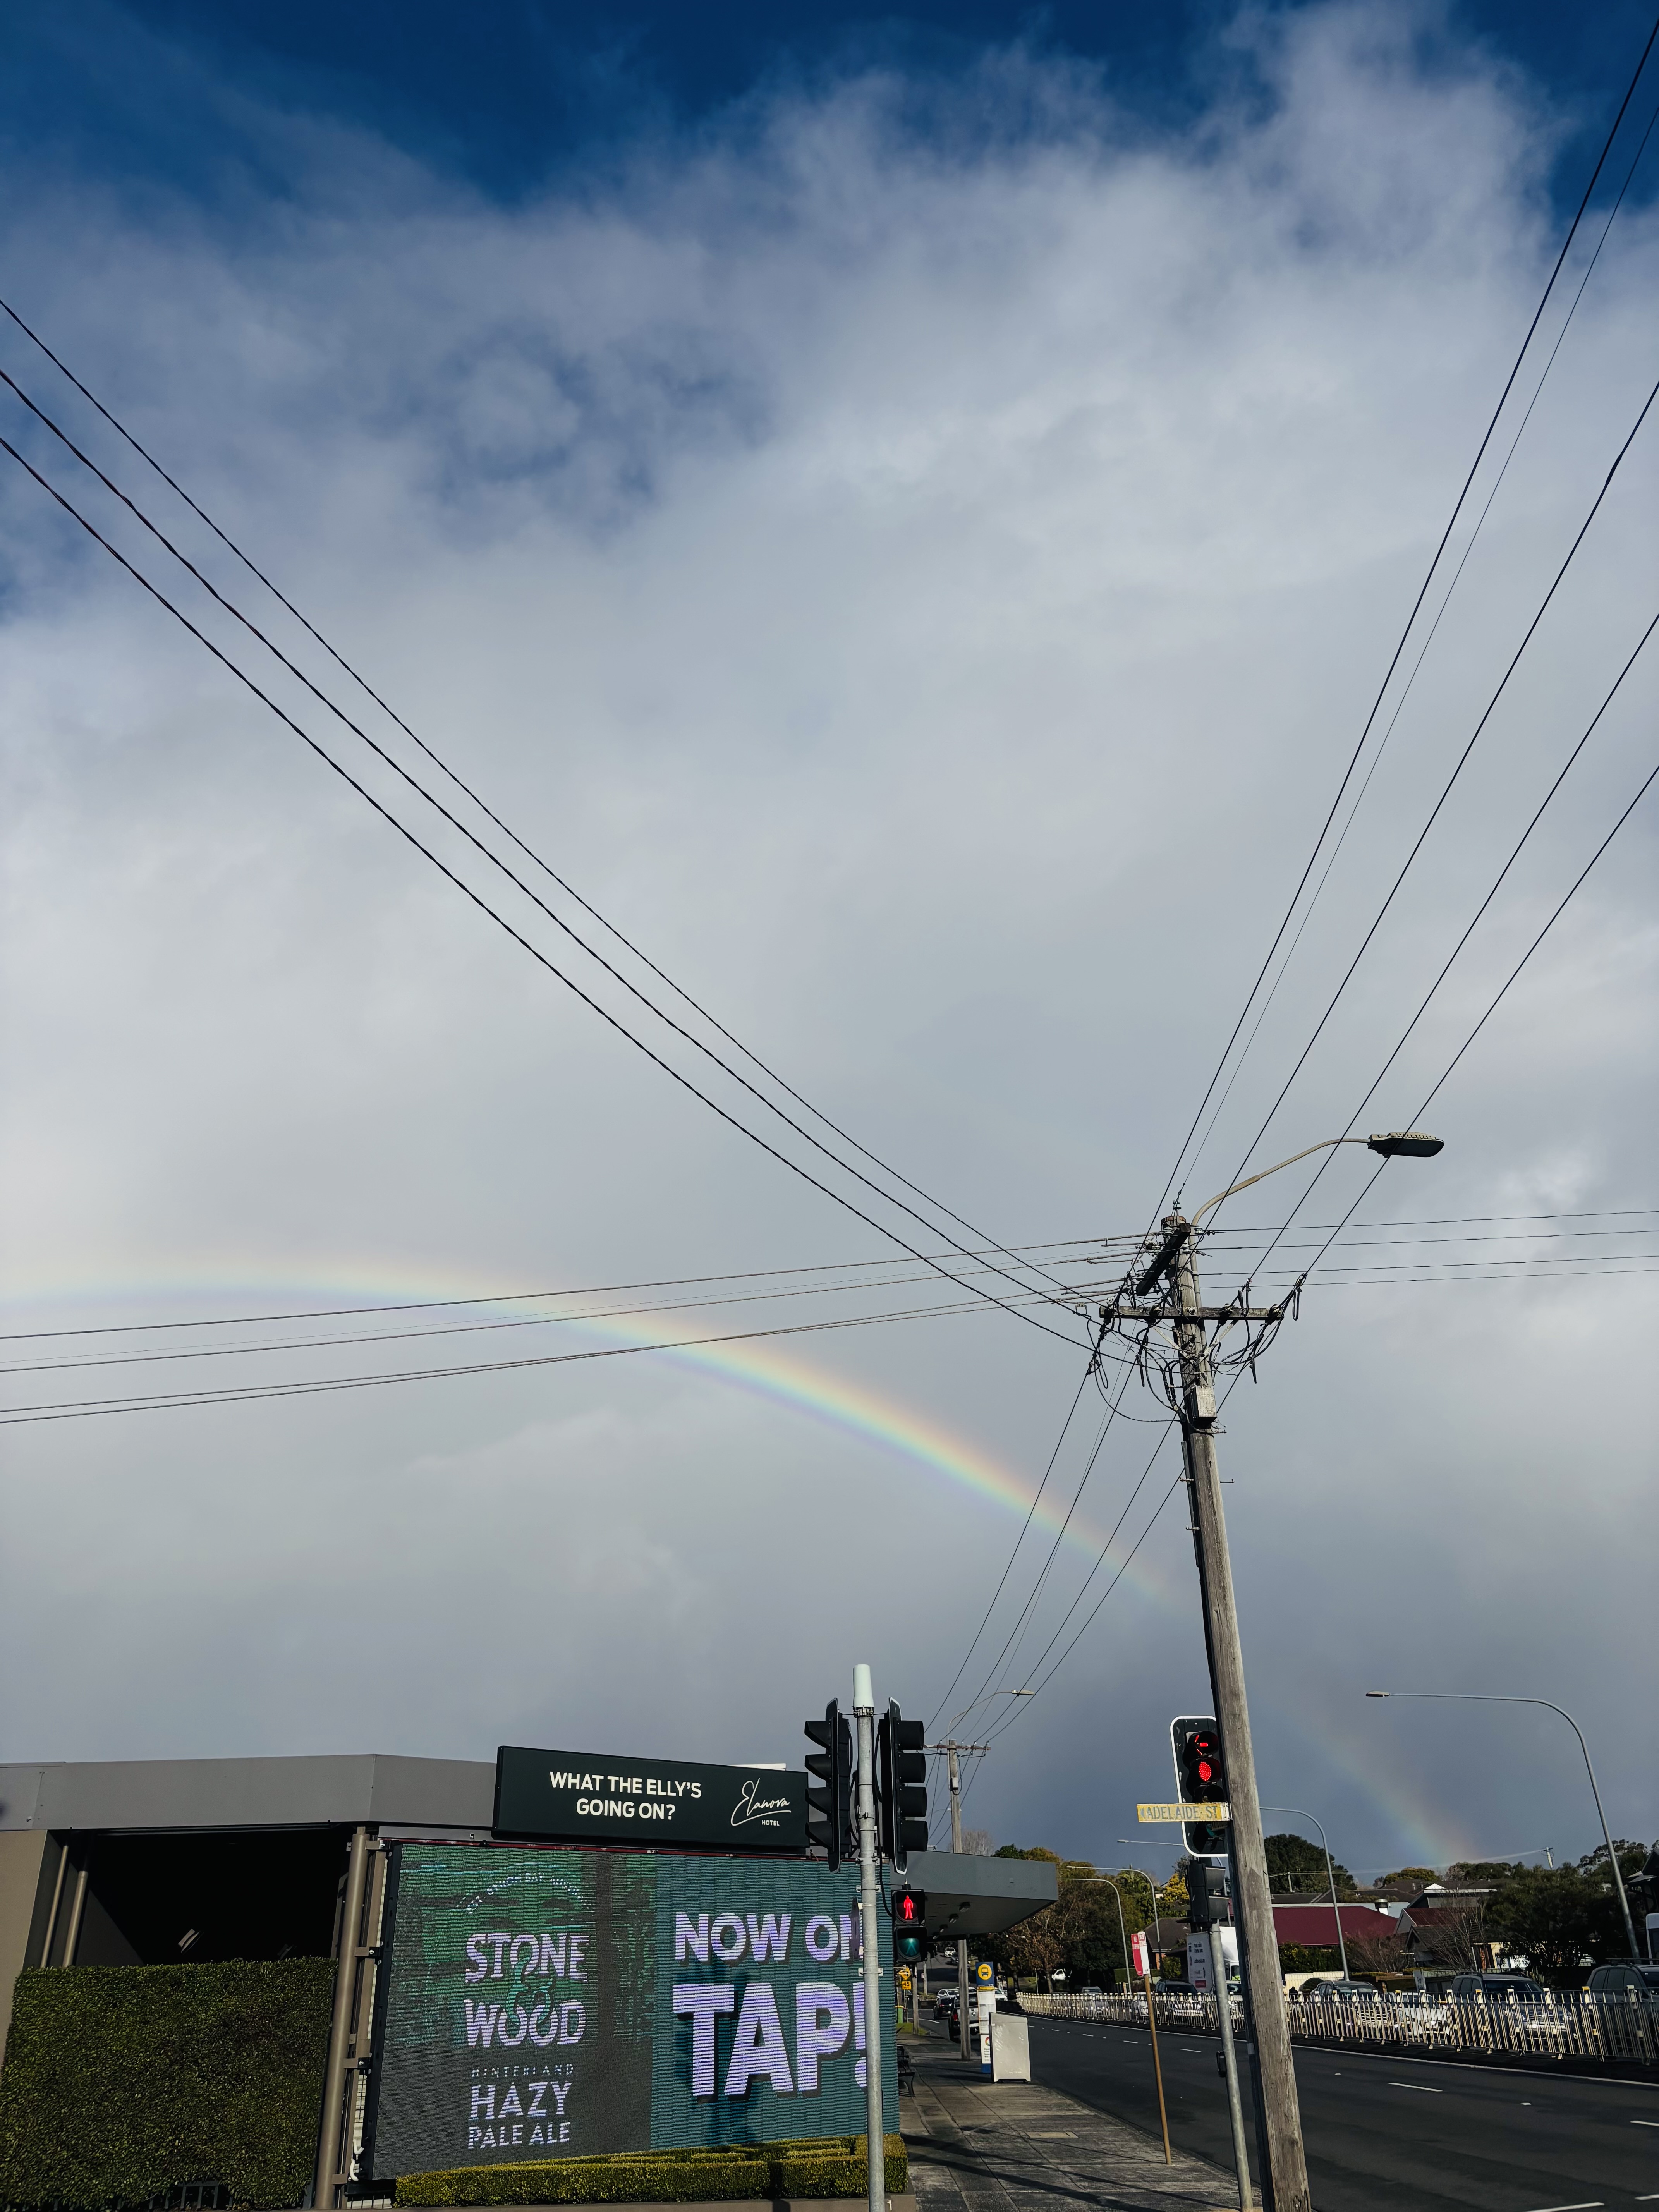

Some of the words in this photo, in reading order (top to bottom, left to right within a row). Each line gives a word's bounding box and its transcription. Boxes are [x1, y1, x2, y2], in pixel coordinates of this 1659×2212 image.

[550, 1771, 604, 1791] WHAT
[607, 1775, 642, 1794] THE
[647, 1779, 702, 1798] ELLY'S
[576, 1798, 635, 1818] GOING
[639, 1802, 676, 1820] ON?
[1147, 1806, 1200, 1820] ADELAIDE
[1205, 1805, 1218, 1819] ST
[675, 1912, 792, 1961] NOW
[465, 1932, 589, 1983] STONE
[464, 1999, 586, 2047] WOOD
[673, 1982, 867, 2096] TAP!
[472, 2064, 574, 2078] HINTERLAND
[469, 2081, 572, 2121] HAZY
[468, 2125, 524, 2149] PALE
[528, 2122, 570, 2145] ALE
